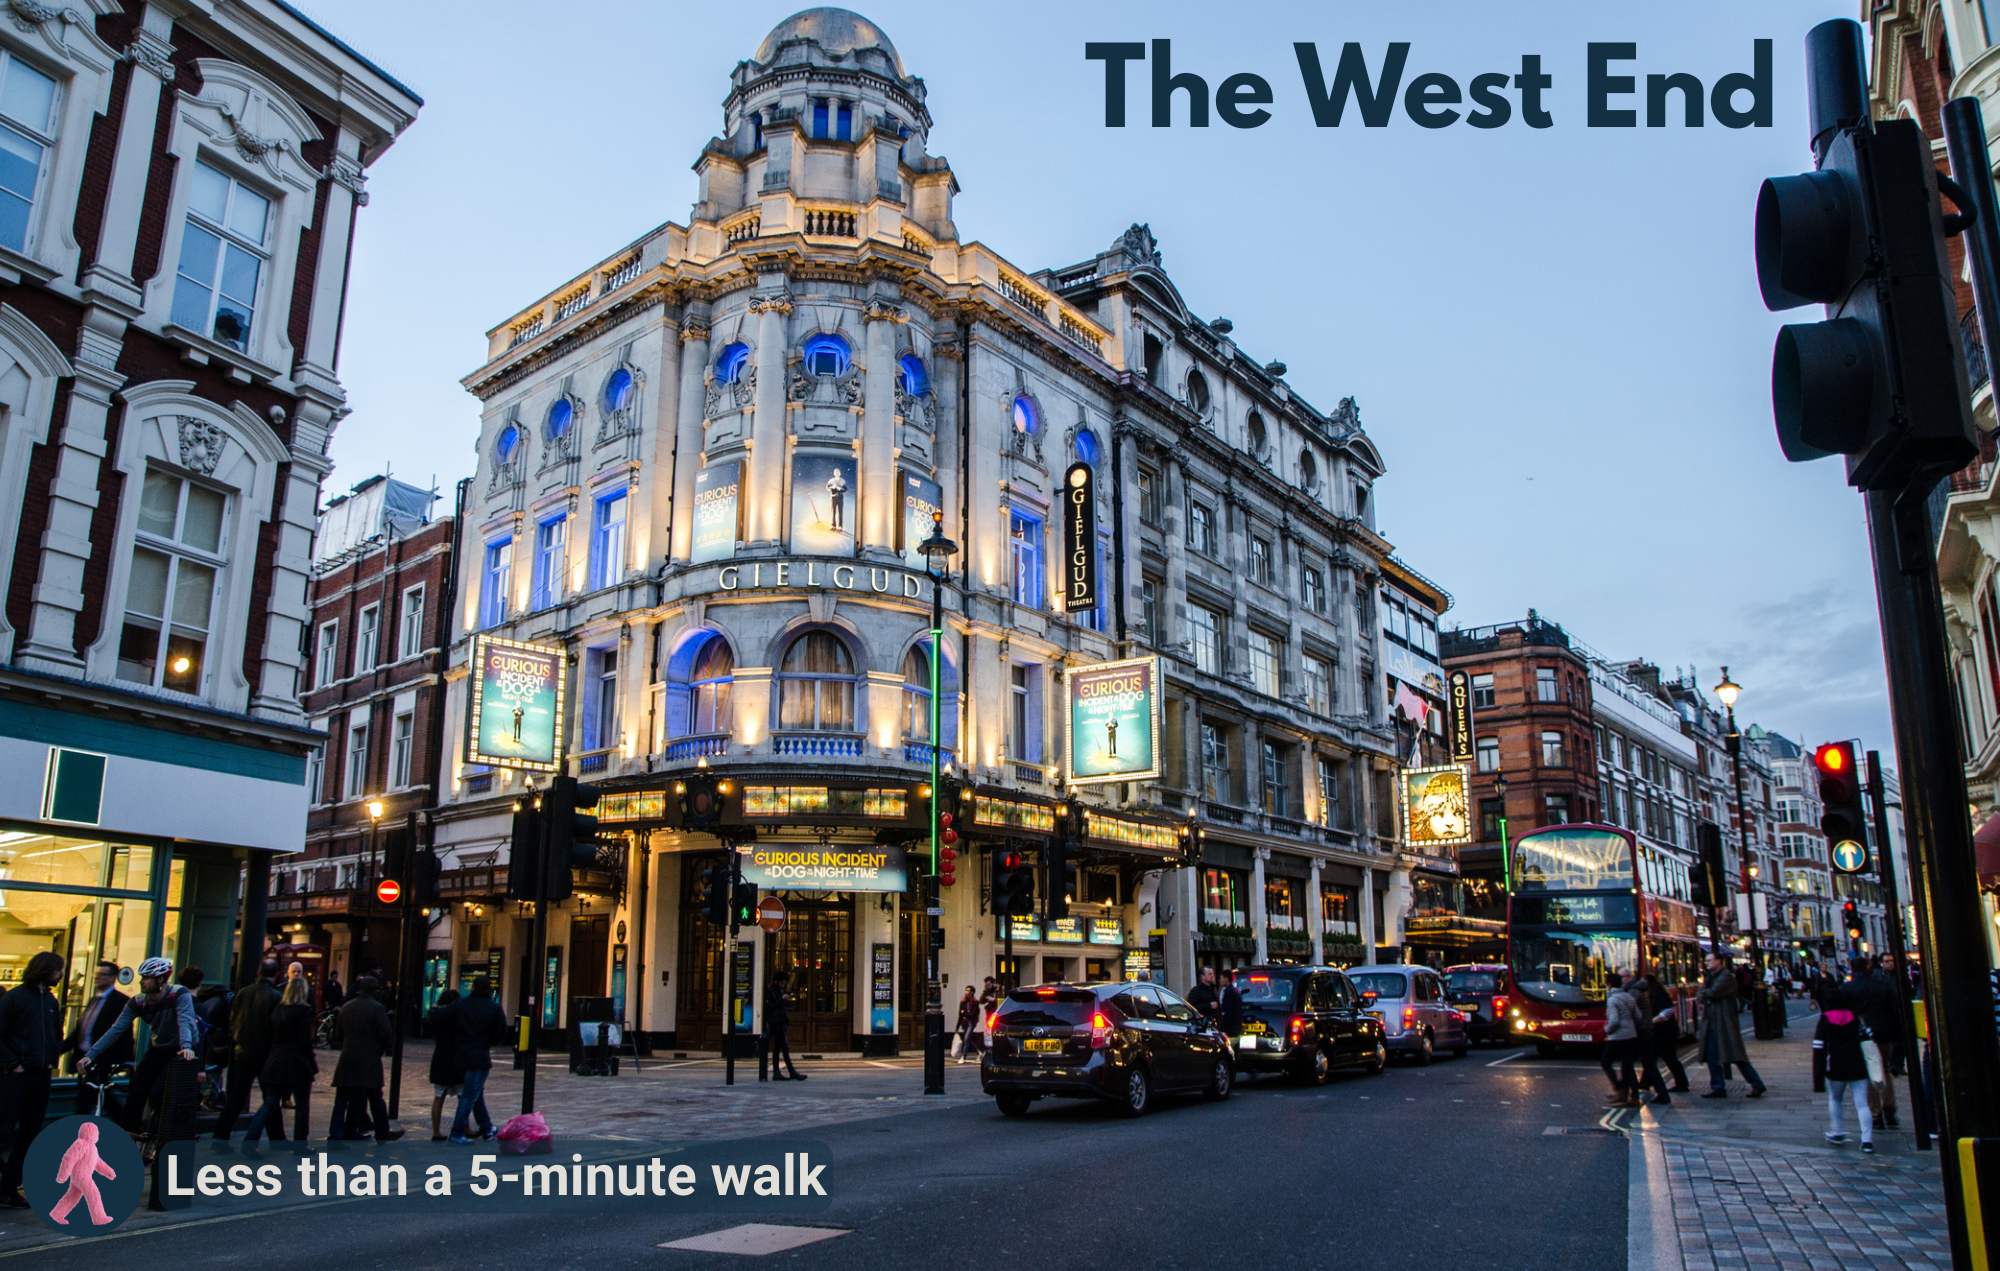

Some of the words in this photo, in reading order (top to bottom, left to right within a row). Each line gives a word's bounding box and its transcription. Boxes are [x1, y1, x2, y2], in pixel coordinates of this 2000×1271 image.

[695, 484, 737, 505] CURIOUS
[1072, 488, 1087, 598] GIELGUD
[719, 562, 920, 598] GIELGUD
[1067, 597, 1093, 608] THEATRE
[491, 656, 551, 677] CURIOUS
[500, 671, 545, 687] INCIDENT
[1080, 676, 1142, 698] CURIOUS
[502, 681, 534, 696] DOG
[1119, 690, 1144, 704] DOG
[1454, 686, 1468, 755] QUEENS
[755, 851, 819, 865] CURIOUS
[822, 851, 887, 867] INCIDENT
[772, 865, 806, 878] DOG
[813, 867, 878, 880] NIGHT-TIME
[1583, 897, 1598, 909] 14
[1576, 911, 1601, 920] Heath
